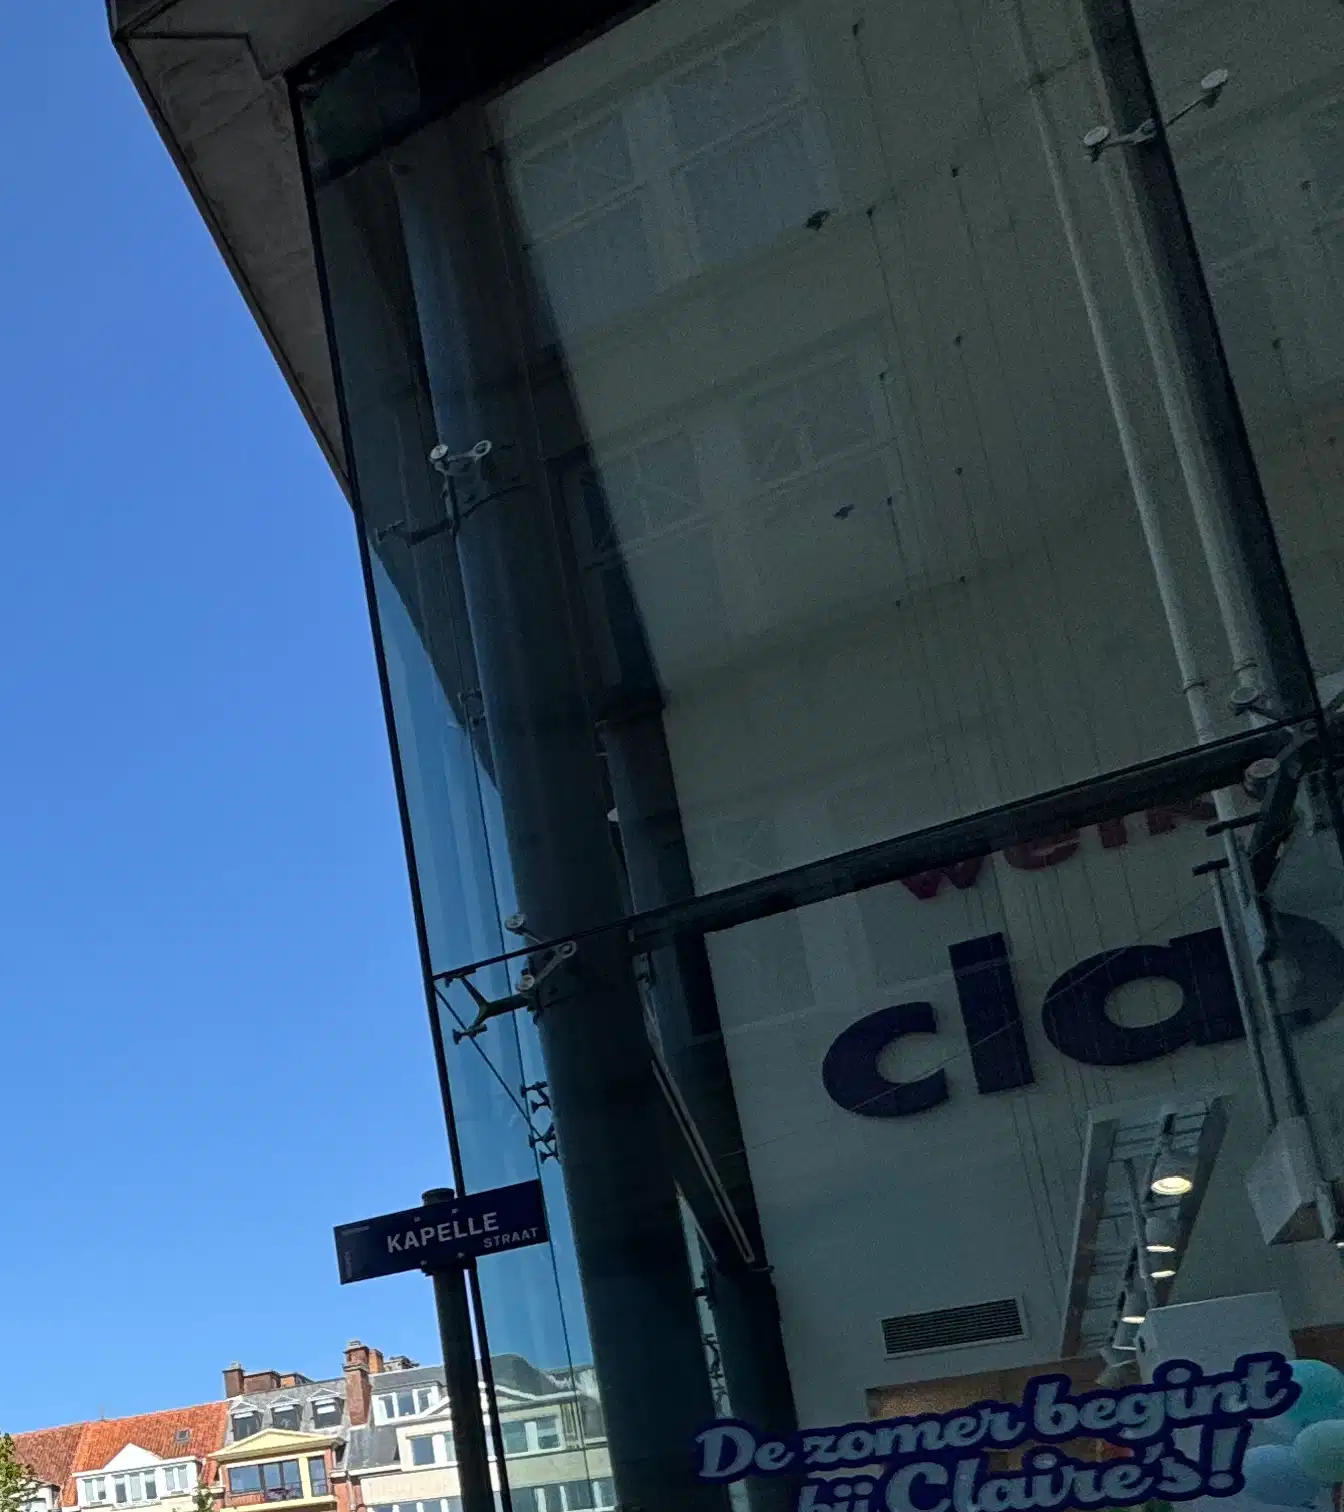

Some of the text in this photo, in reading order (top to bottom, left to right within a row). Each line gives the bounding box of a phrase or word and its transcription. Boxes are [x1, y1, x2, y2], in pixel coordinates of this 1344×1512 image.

[386, 1211, 500, 1253] KAPELLE
[483, 1226, 539, 1248] STRAAT
[693, 1359, 1294, 1479] De zomer begint
